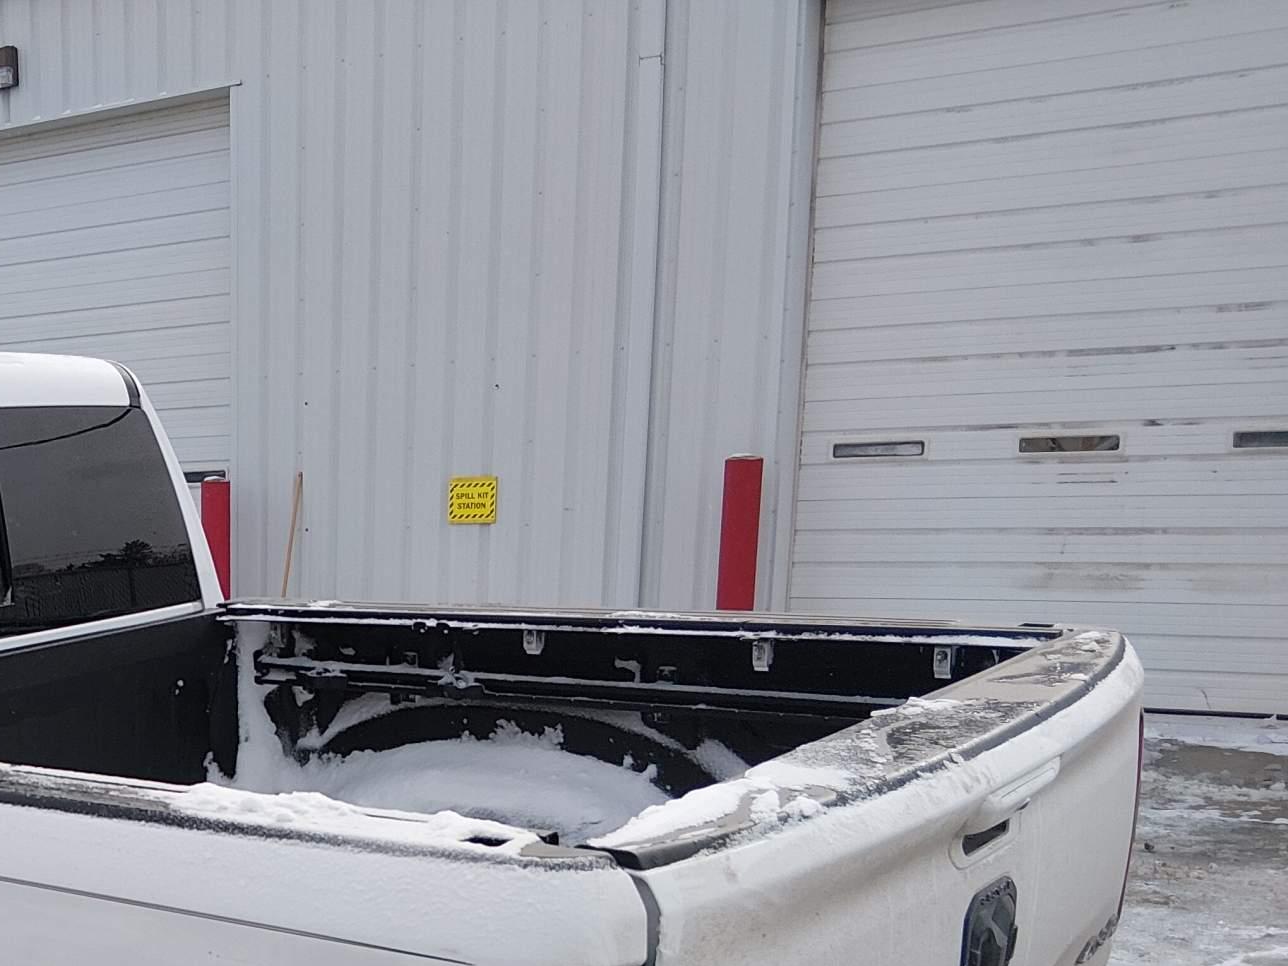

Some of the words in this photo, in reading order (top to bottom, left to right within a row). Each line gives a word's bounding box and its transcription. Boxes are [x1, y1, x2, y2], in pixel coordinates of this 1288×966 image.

[455, 492, 475, 500] SPILL
[477, 491, 489, 499] KIT
[456, 502, 486, 510] STATION
